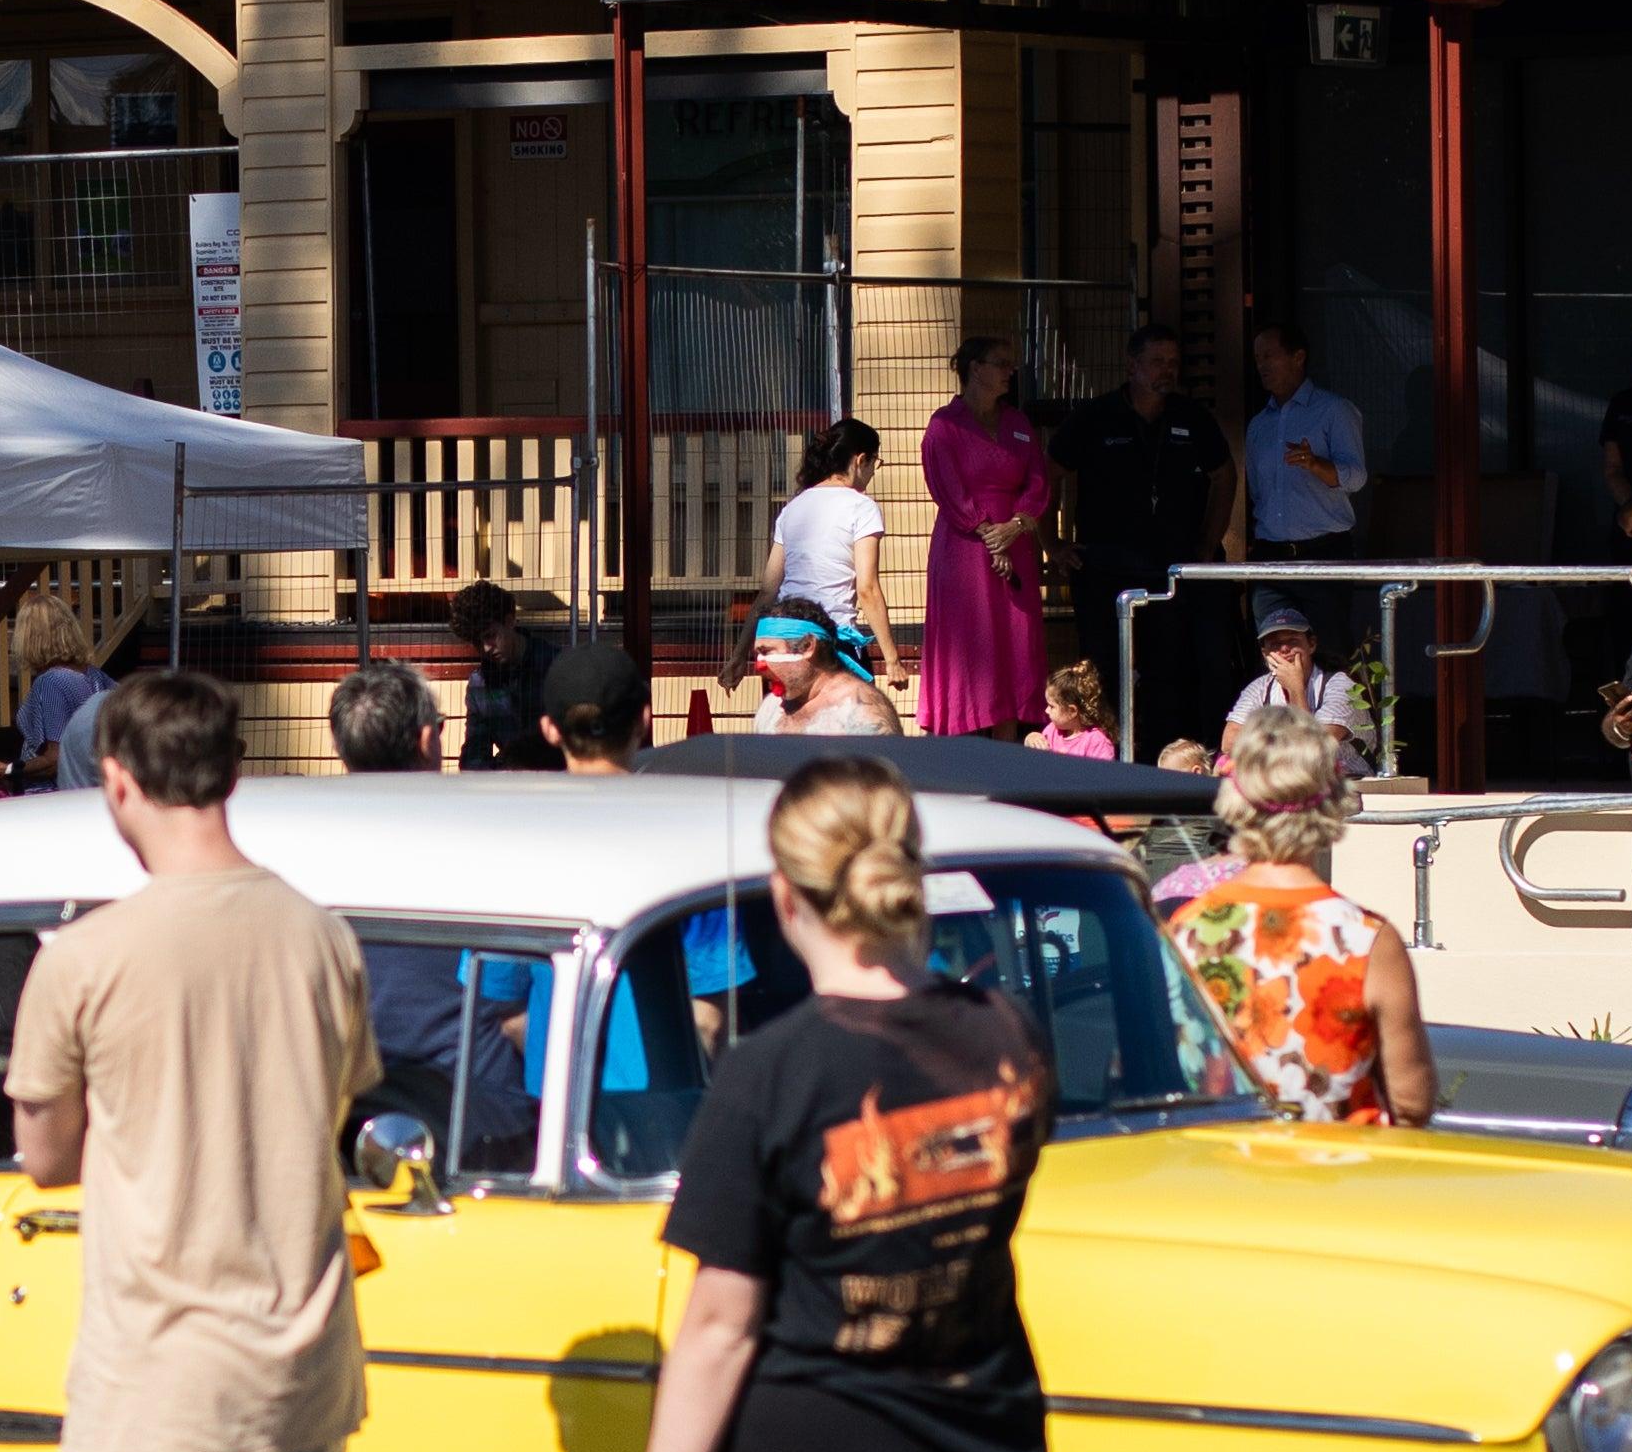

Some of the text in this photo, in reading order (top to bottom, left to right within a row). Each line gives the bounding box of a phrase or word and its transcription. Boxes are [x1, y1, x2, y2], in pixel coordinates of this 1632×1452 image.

[515, 120, 541, 139] NO
[513, 144, 565, 156] SMOKING
[203, 266, 234, 275] DANGER
[200, 279, 237, 287] CONSTRUCTION
[201, 337, 221, 345] MUST
